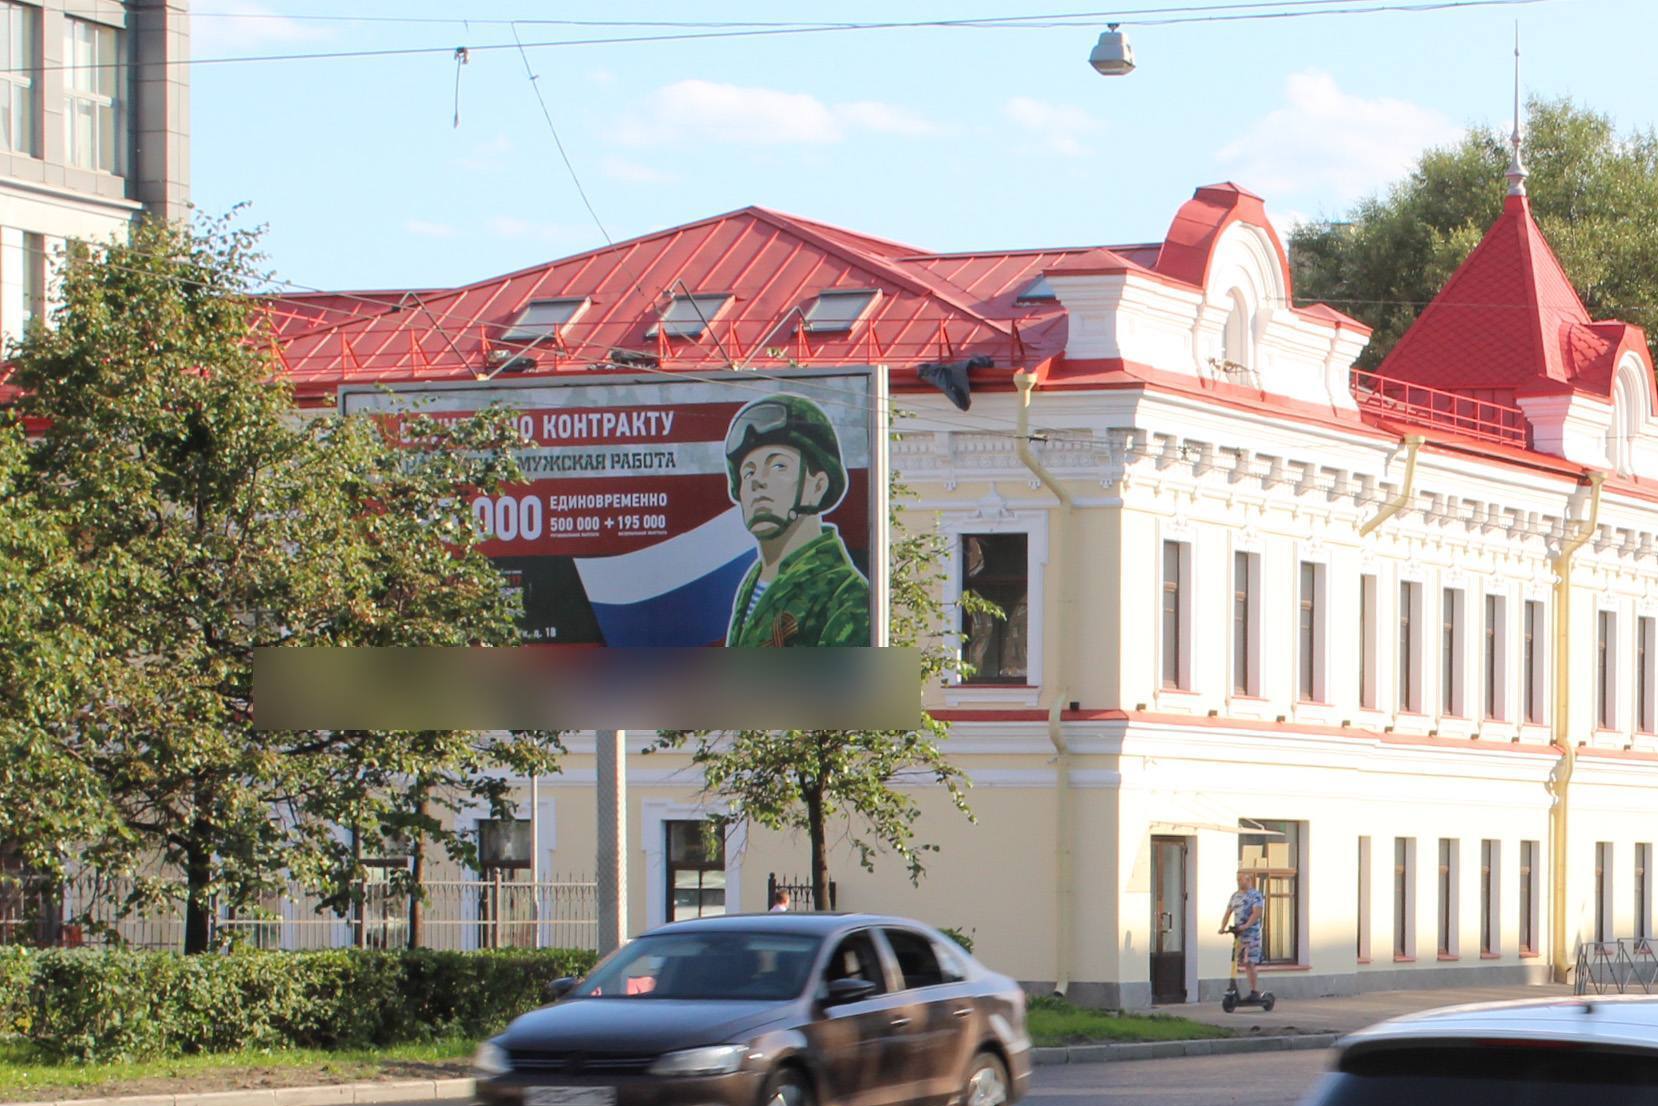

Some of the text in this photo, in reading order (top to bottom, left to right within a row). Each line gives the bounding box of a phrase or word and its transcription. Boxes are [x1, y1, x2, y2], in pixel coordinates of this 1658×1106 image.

[543, 410, 674, 439] КОНТРАКТУ
[516, 454, 606, 472] МУЖСКАЯ
[611, 452, 676, 469] РАБОТА
[550, 492, 667, 511] ЕДИНОВРЕМЕННО
[550, 514, 666, 531] 500 000 + 195 000
